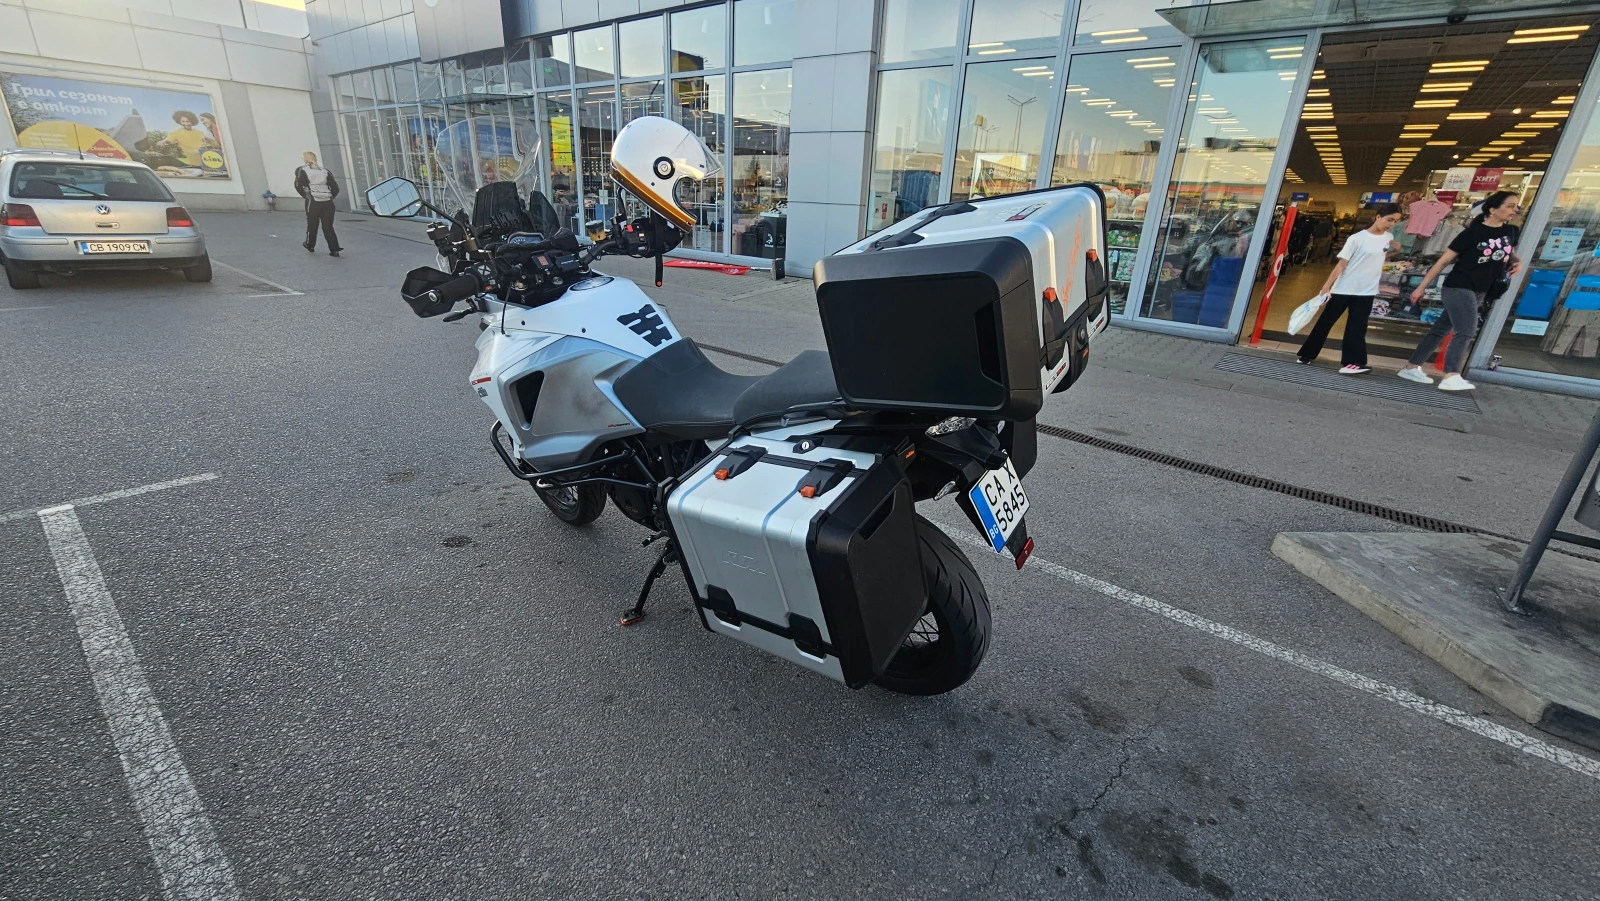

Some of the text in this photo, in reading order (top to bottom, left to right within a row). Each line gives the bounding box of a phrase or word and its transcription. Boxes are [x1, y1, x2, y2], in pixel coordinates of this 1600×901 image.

[11, 82, 133, 105] Грил сезонът
[17, 100, 107, 116] е открит
[89, 243, 148, 252] CB 1909 CM
[985, 475, 1005, 506] CA
[995, 484, 1025, 532] 5845
[989, 523, 999, 540] BG
